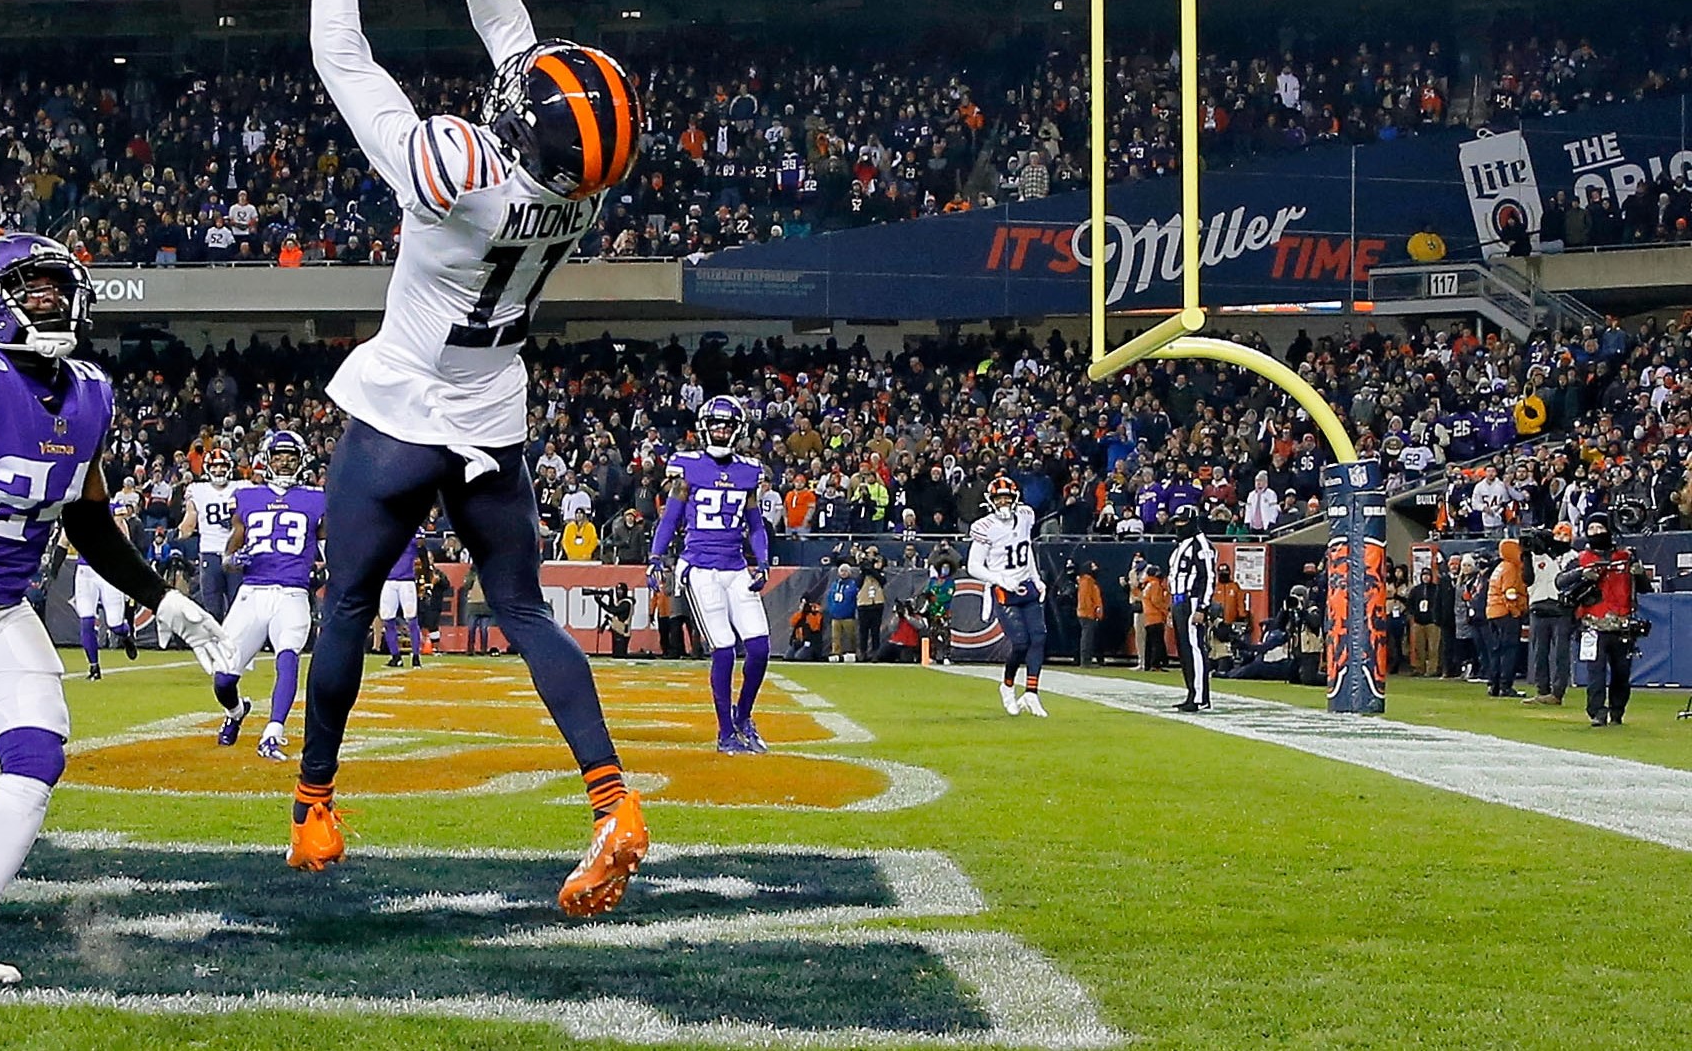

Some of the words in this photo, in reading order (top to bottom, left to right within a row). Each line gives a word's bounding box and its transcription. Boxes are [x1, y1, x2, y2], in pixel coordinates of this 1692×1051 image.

[1564, 131, 1622, 167] THE
[1468, 157, 1530, 200] Lite
[500, 195, 602, 240] MOONEY
[986, 227, 1078, 274] IT'S
[1271, 235, 1386, 282] TIME
[1432, 275, 1456, 294] 117
[1453, 420, 1471, 437] 26
[1300, 455, 1314, 471] 96
[1405, 453, 1421, 466] 52
[695, 488, 748, 529] 27
[1416, 494, 1438, 505] BUILT
[248, 511, 308, 556] 23
[1005, 541, 1030, 570] 10
